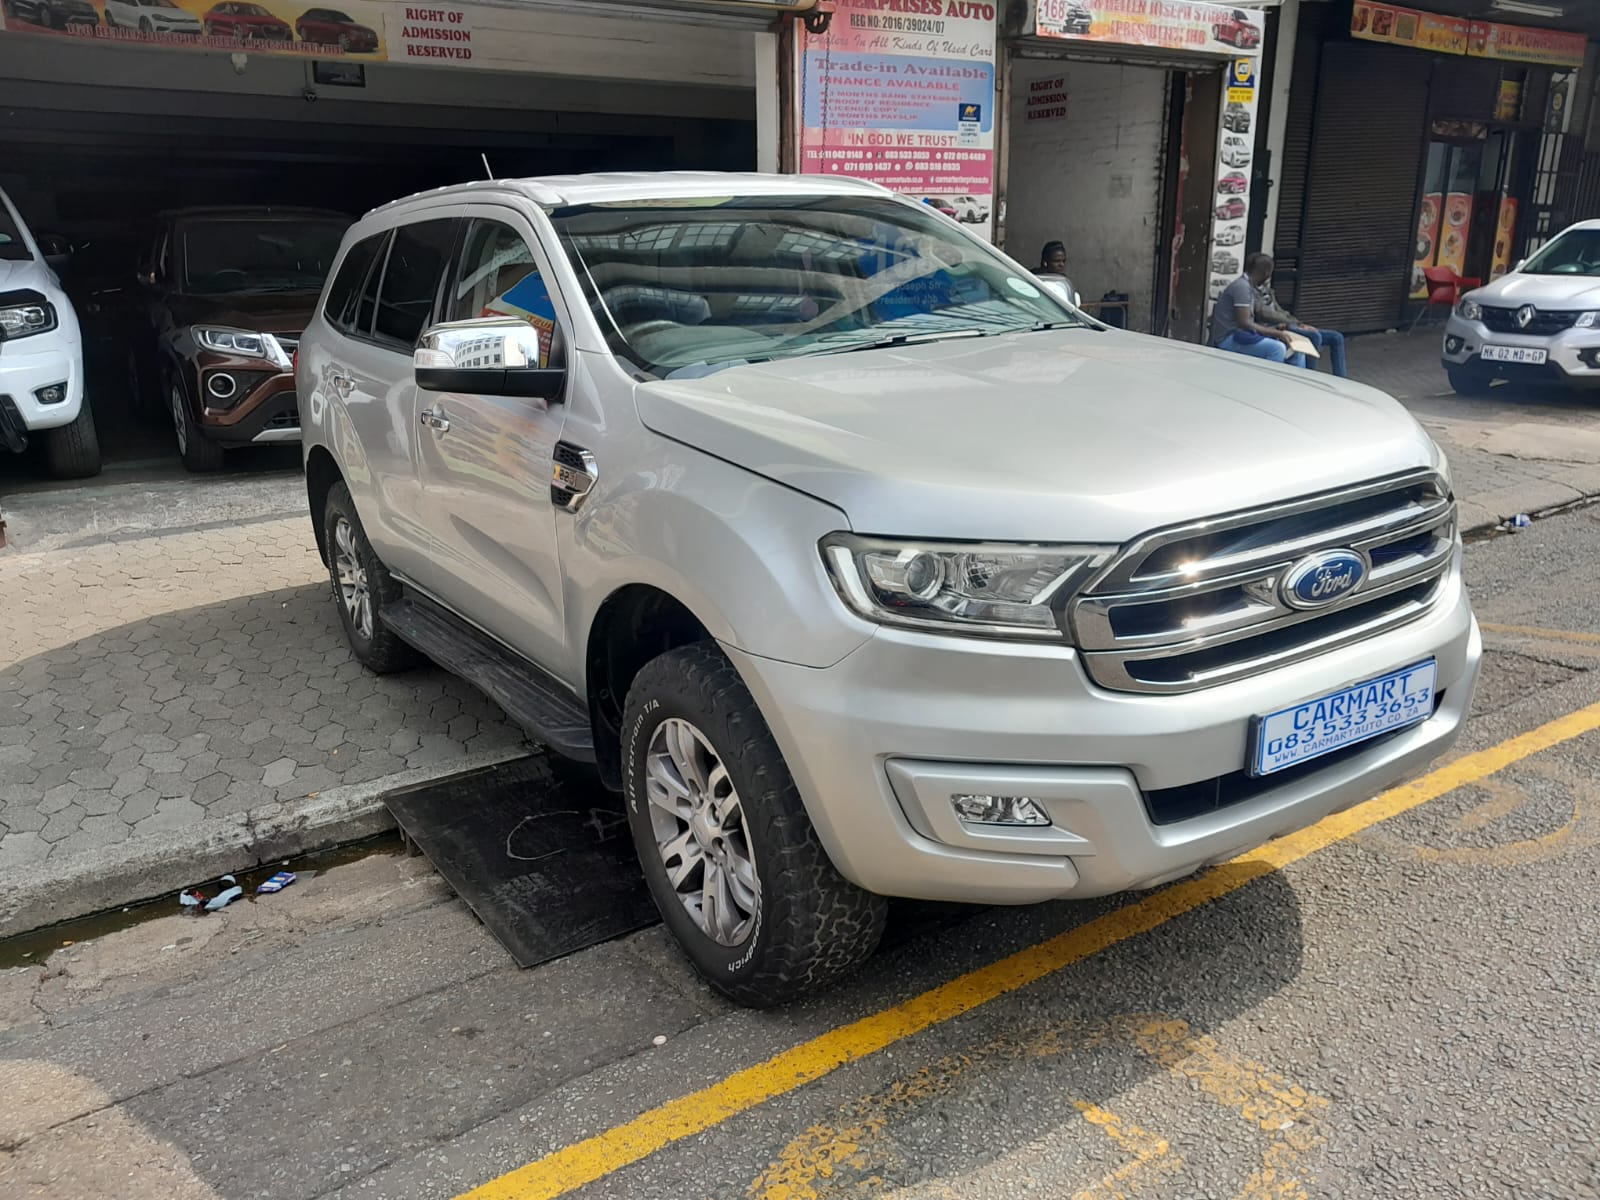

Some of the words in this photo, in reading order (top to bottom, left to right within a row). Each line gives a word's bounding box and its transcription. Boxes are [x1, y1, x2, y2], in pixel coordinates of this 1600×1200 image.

[405, 8, 445, 22] RIGHT
[448, 12, 464, 23] OF
[838, 0, 943, 16] TERPRISES
[945, 4, 995, 21] AUTO
[1043, 0, 1065, 20] 168
[850, 14, 865, 27] REG
[867, 15, 881, 28] NO:
[882, 17, 945, 34] 2016/39024/07
[402, 26, 472, 41] ADMISSION
[407, 44, 472, 60] RESERVED
[808, 34, 849, 47] Dealers
[854, 35, 866, 47] In
[870, 36, 889, 49] All
[892, 37, 922, 51] Kinds
[925, 40, 938, 55] Of
[942, 41, 968, 55] Used
[969, 44, 993, 57] Cars
[815, 58, 898, 74] Trade-in
[904, 63, 988, 80] Available
[819, 76, 882, 88] FINANCE
[886, 79, 960, 92] AVAILABLE
[1030, 80, 1053, 91] RIGHT
[1055, 78, 1064, 89] OF
[879, 99, 931, 108] RESIDENCE
[910, 94, 963, 102] STATEMENT
[1027, 93, 1067, 105] ADMISSION
[881, 113, 919, 121] PAYSLIP
[1027, 107, 1066, 119] RESERVED
[868, 133, 893, 146] GOD
[896, 134, 914, 146] WE
[918, 134, 958, 147] TRUST'
[1532, 351, 1544, 361] GP
[1311, 562, 1353, 597] Ford
[1293, 673, 1412, 731] CARMART
[1267, 727, 1316, 756] 083
[1323, 709, 1368, 737] 533
[1374, 687, 1430, 719] 3653
[628, 714, 644, 814] All-Terrain
[643, 699, 660, 714] T/A
